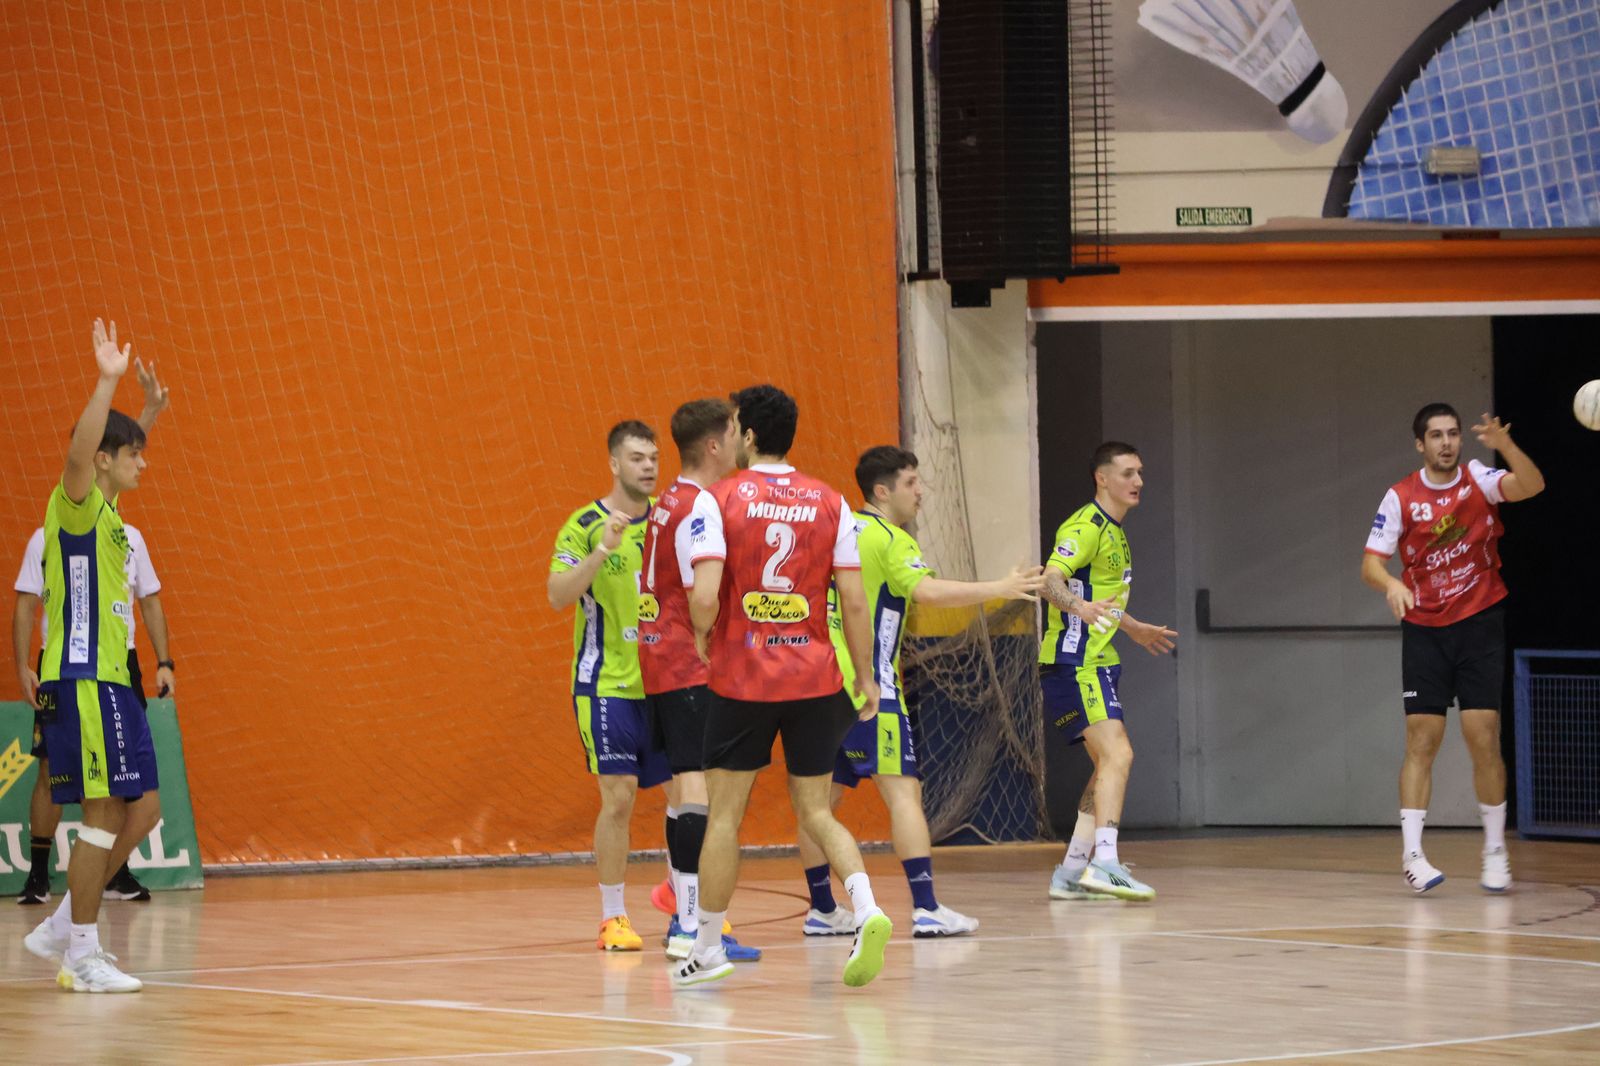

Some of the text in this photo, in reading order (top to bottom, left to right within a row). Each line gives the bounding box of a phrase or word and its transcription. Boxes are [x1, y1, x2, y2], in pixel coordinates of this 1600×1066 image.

[1179, 208, 1249, 225] SALIDA EMERGENCIA
[767, 486, 821, 500] TRIOCAR
[747, 502, 817, 522] MORÁN
[1410, 502, 1433, 522] 23
[762, 522, 796, 592] 2
